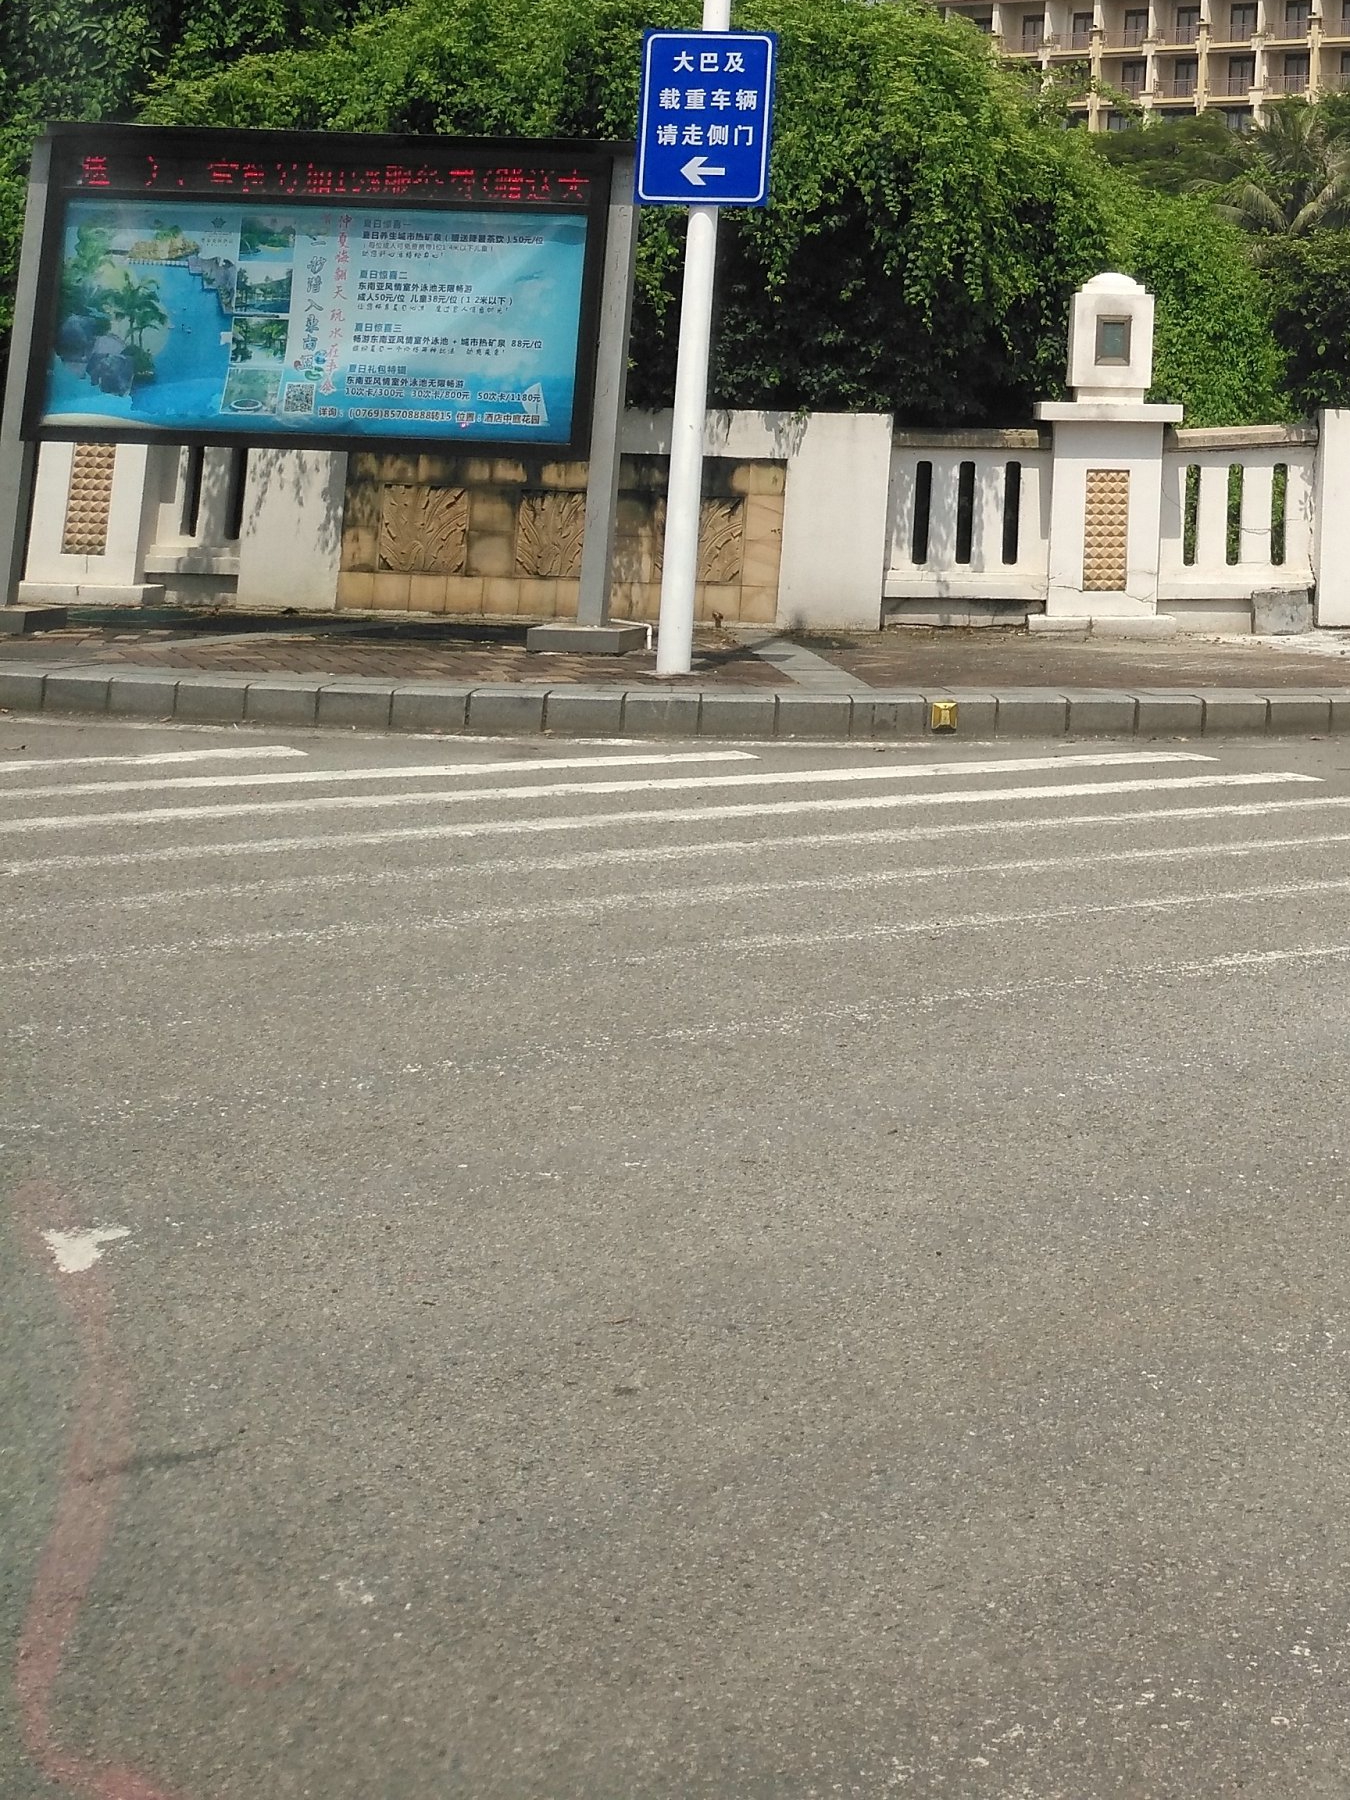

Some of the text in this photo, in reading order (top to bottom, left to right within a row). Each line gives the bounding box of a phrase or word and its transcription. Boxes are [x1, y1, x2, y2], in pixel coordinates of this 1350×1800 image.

[672, 50, 746, 73] 大巴及
[658, 87, 758, 111] 载重车辆
[655, 123, 754, 147] 请走侧门
[359, 269, 408, 281] 夏日惊喜二
[357, 281, 473, 294] 东南亚风情室外泳池无限畅游
[357, 293, 405, 304] 成人50元/位
[354, 322, 402, 333] 夏日惊喜三
[511, 339, 543, 350] 88元/位
[346, 376, 465, 389] 东南亚风情室外泳池无限畅游
[345, 387, 541, 403] 10次卡/300元 30次卡/800元 50次卡/1180元
